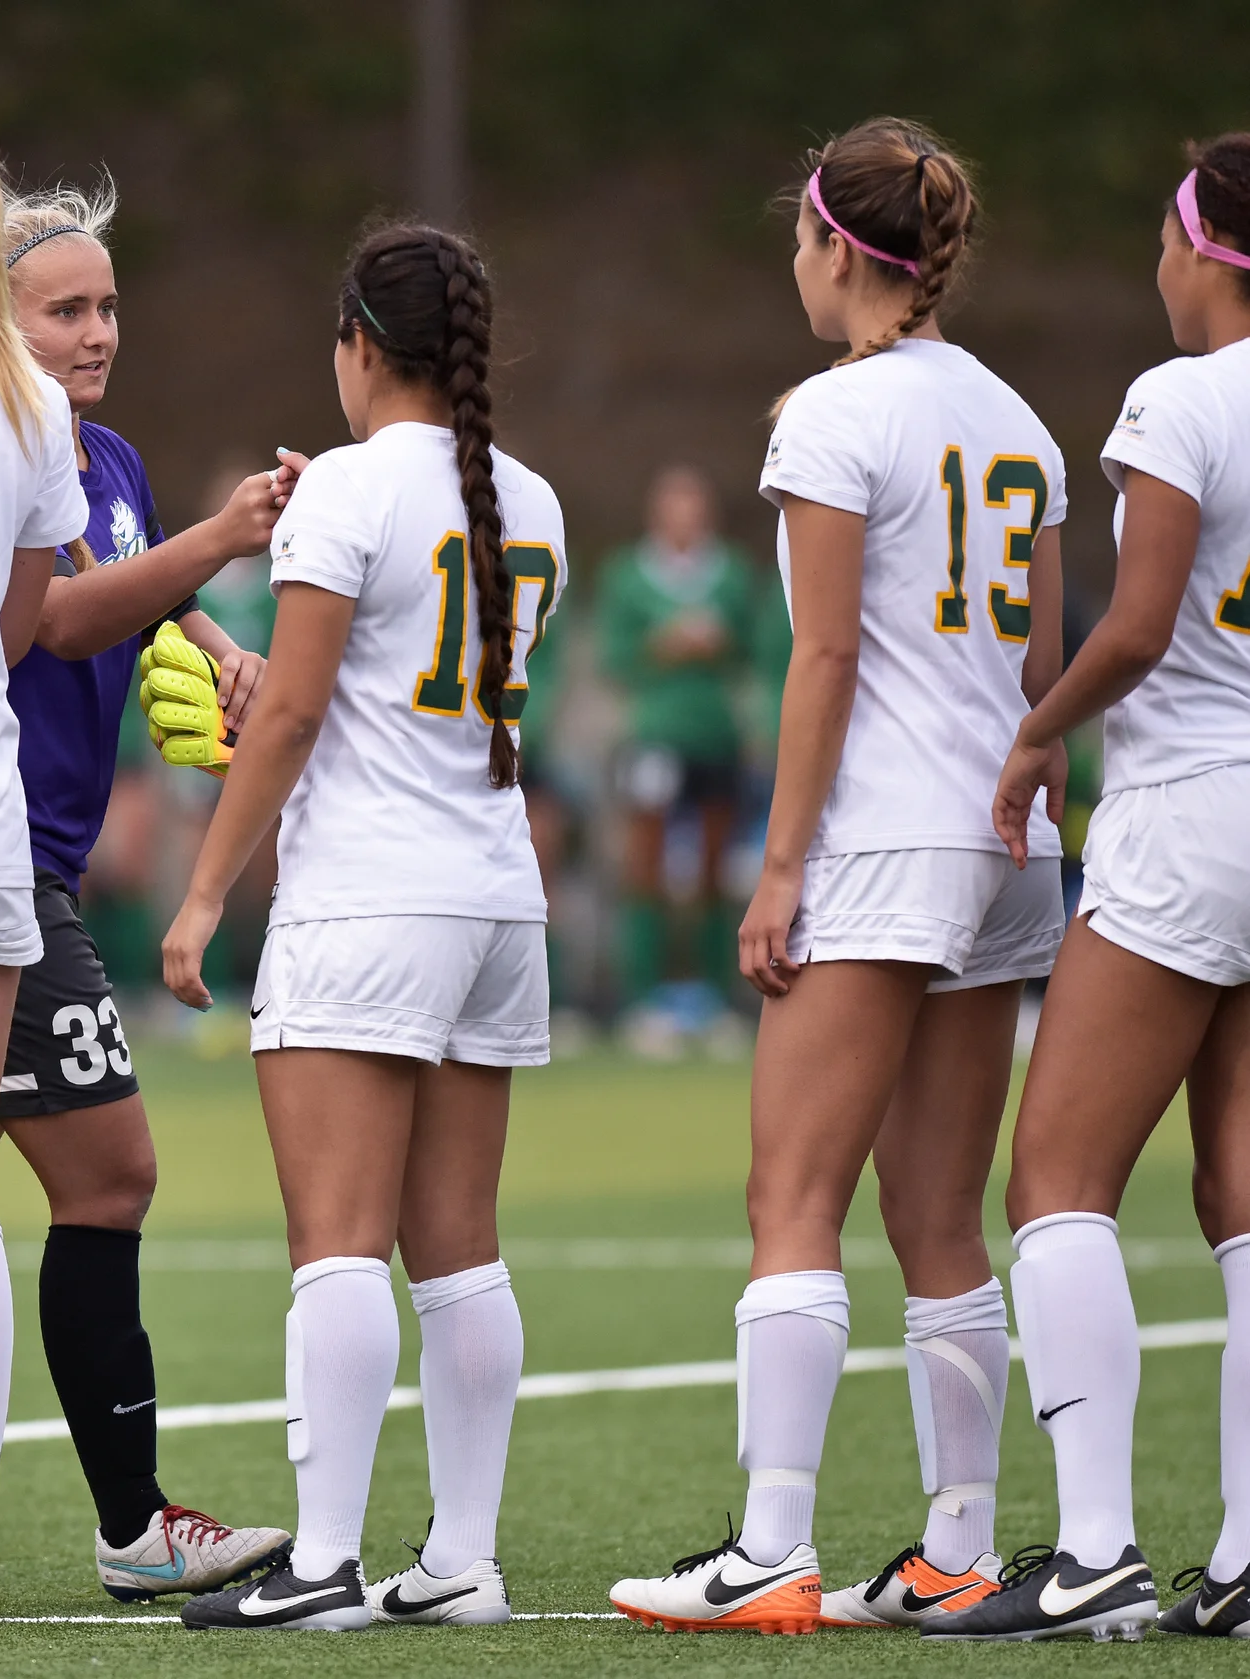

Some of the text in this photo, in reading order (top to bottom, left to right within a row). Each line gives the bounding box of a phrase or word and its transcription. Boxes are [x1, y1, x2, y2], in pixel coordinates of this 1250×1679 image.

[412, 529, 559, 726] 10
[934, 443, 1048, 645] 13
[52, 995, 132, 1085] 33
